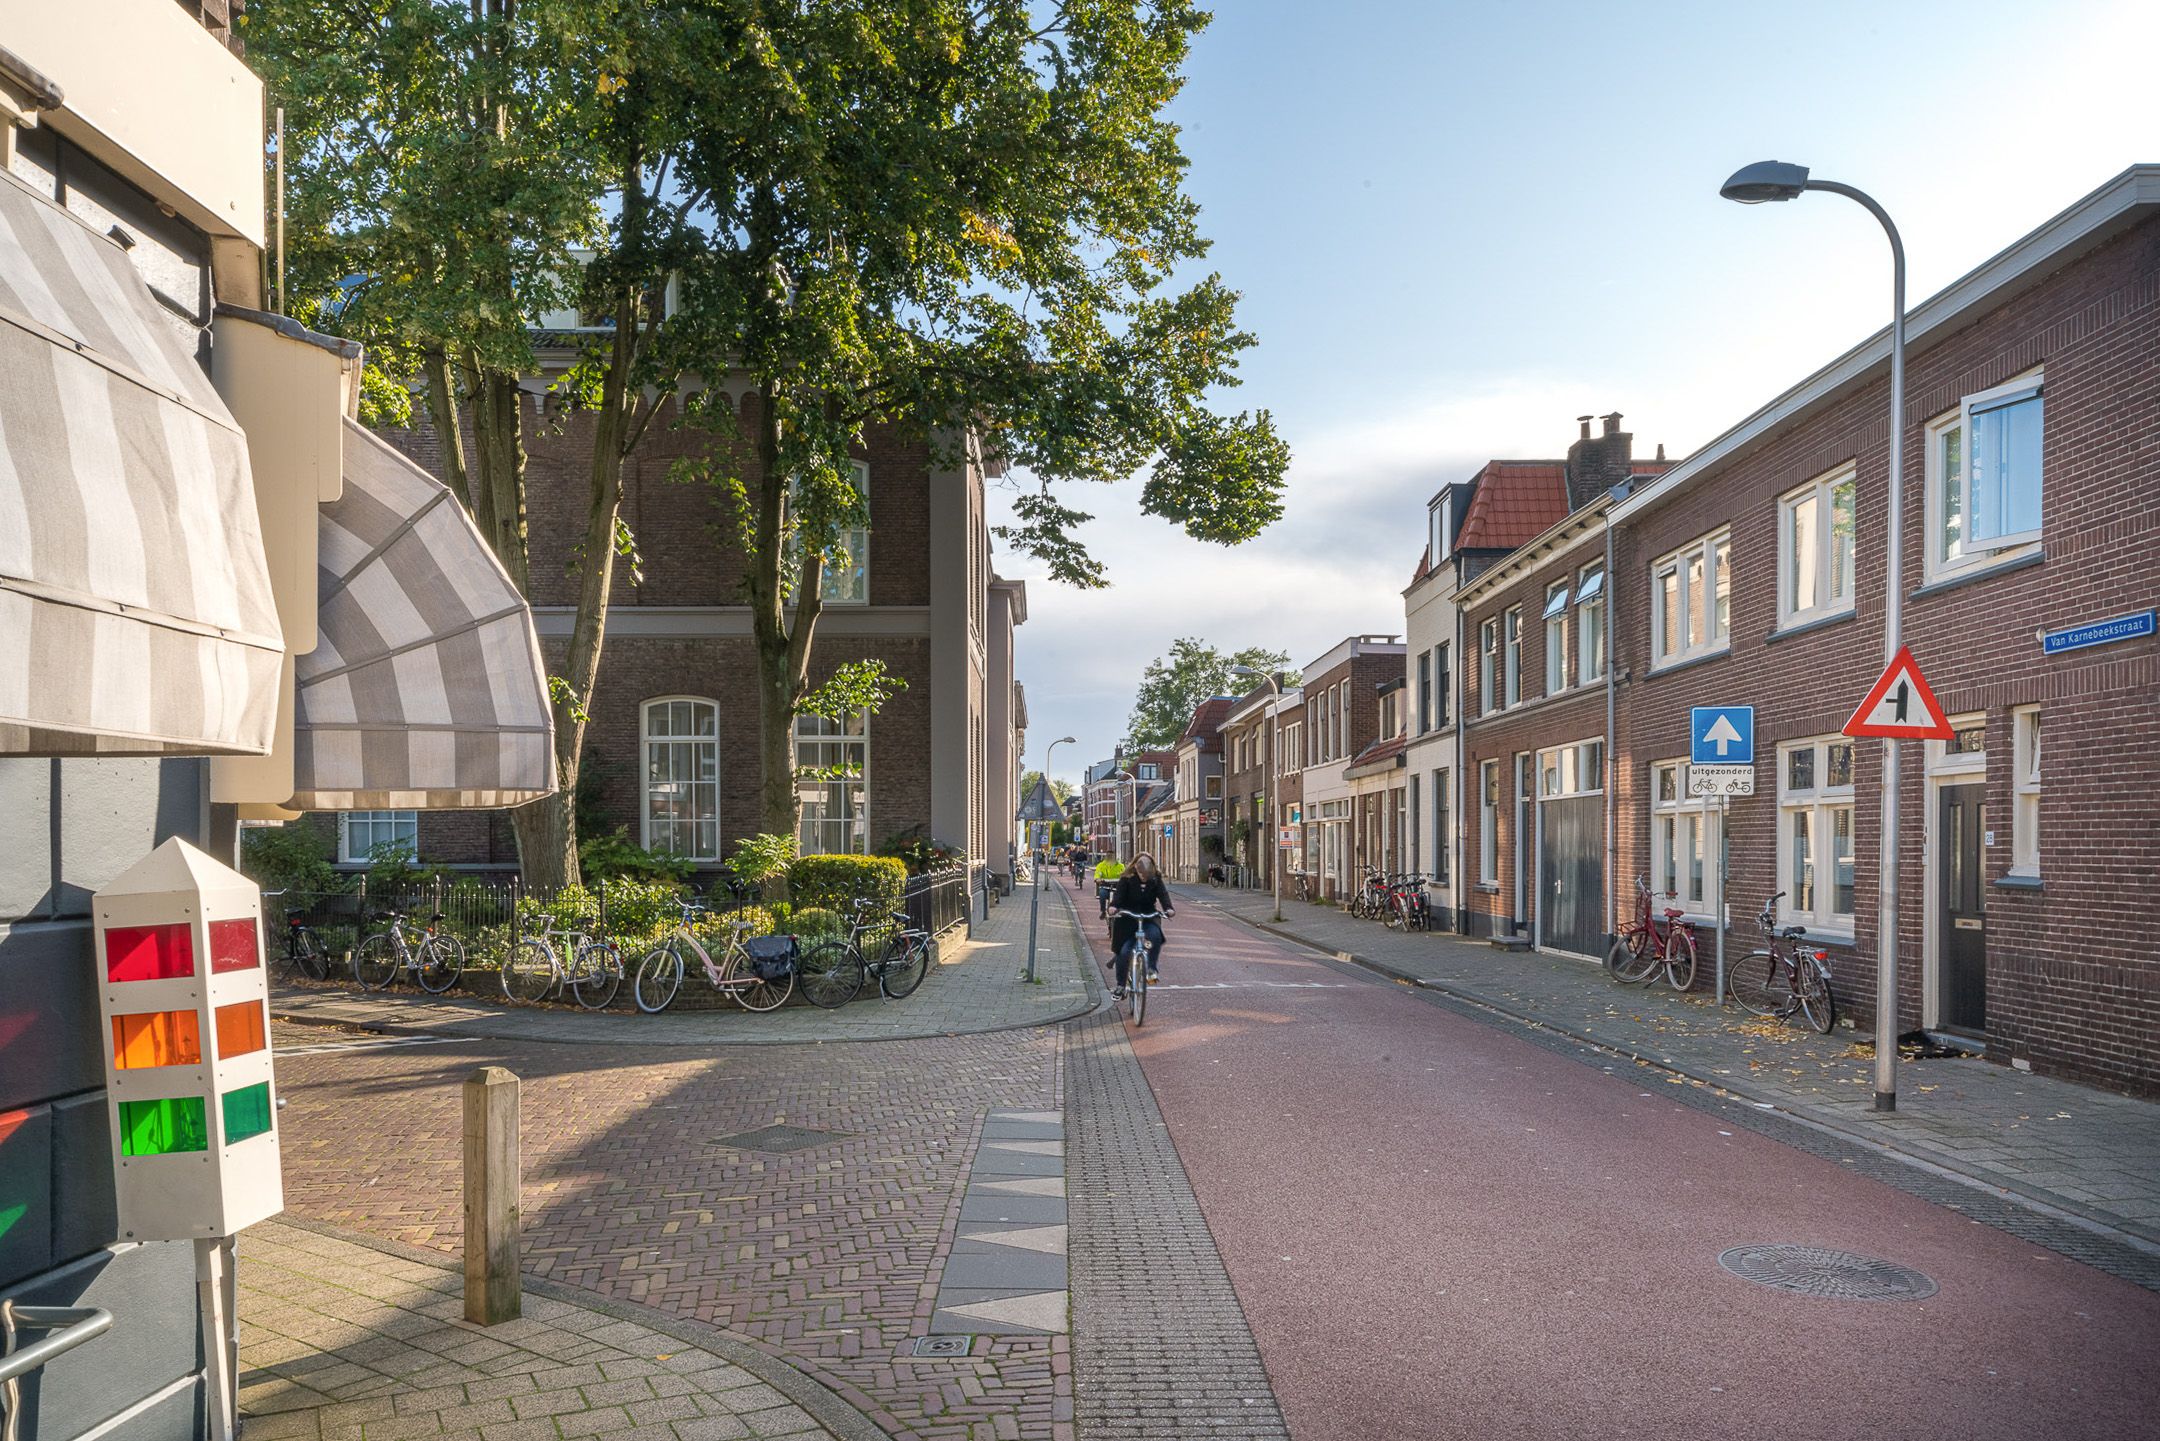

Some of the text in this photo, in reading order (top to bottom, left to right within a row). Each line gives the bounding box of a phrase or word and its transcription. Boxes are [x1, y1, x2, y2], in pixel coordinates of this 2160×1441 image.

[2051, 620, 2143, 647] Van Karnebeekstraat
[1692, 768, 1752, 776] uitgezonderd
